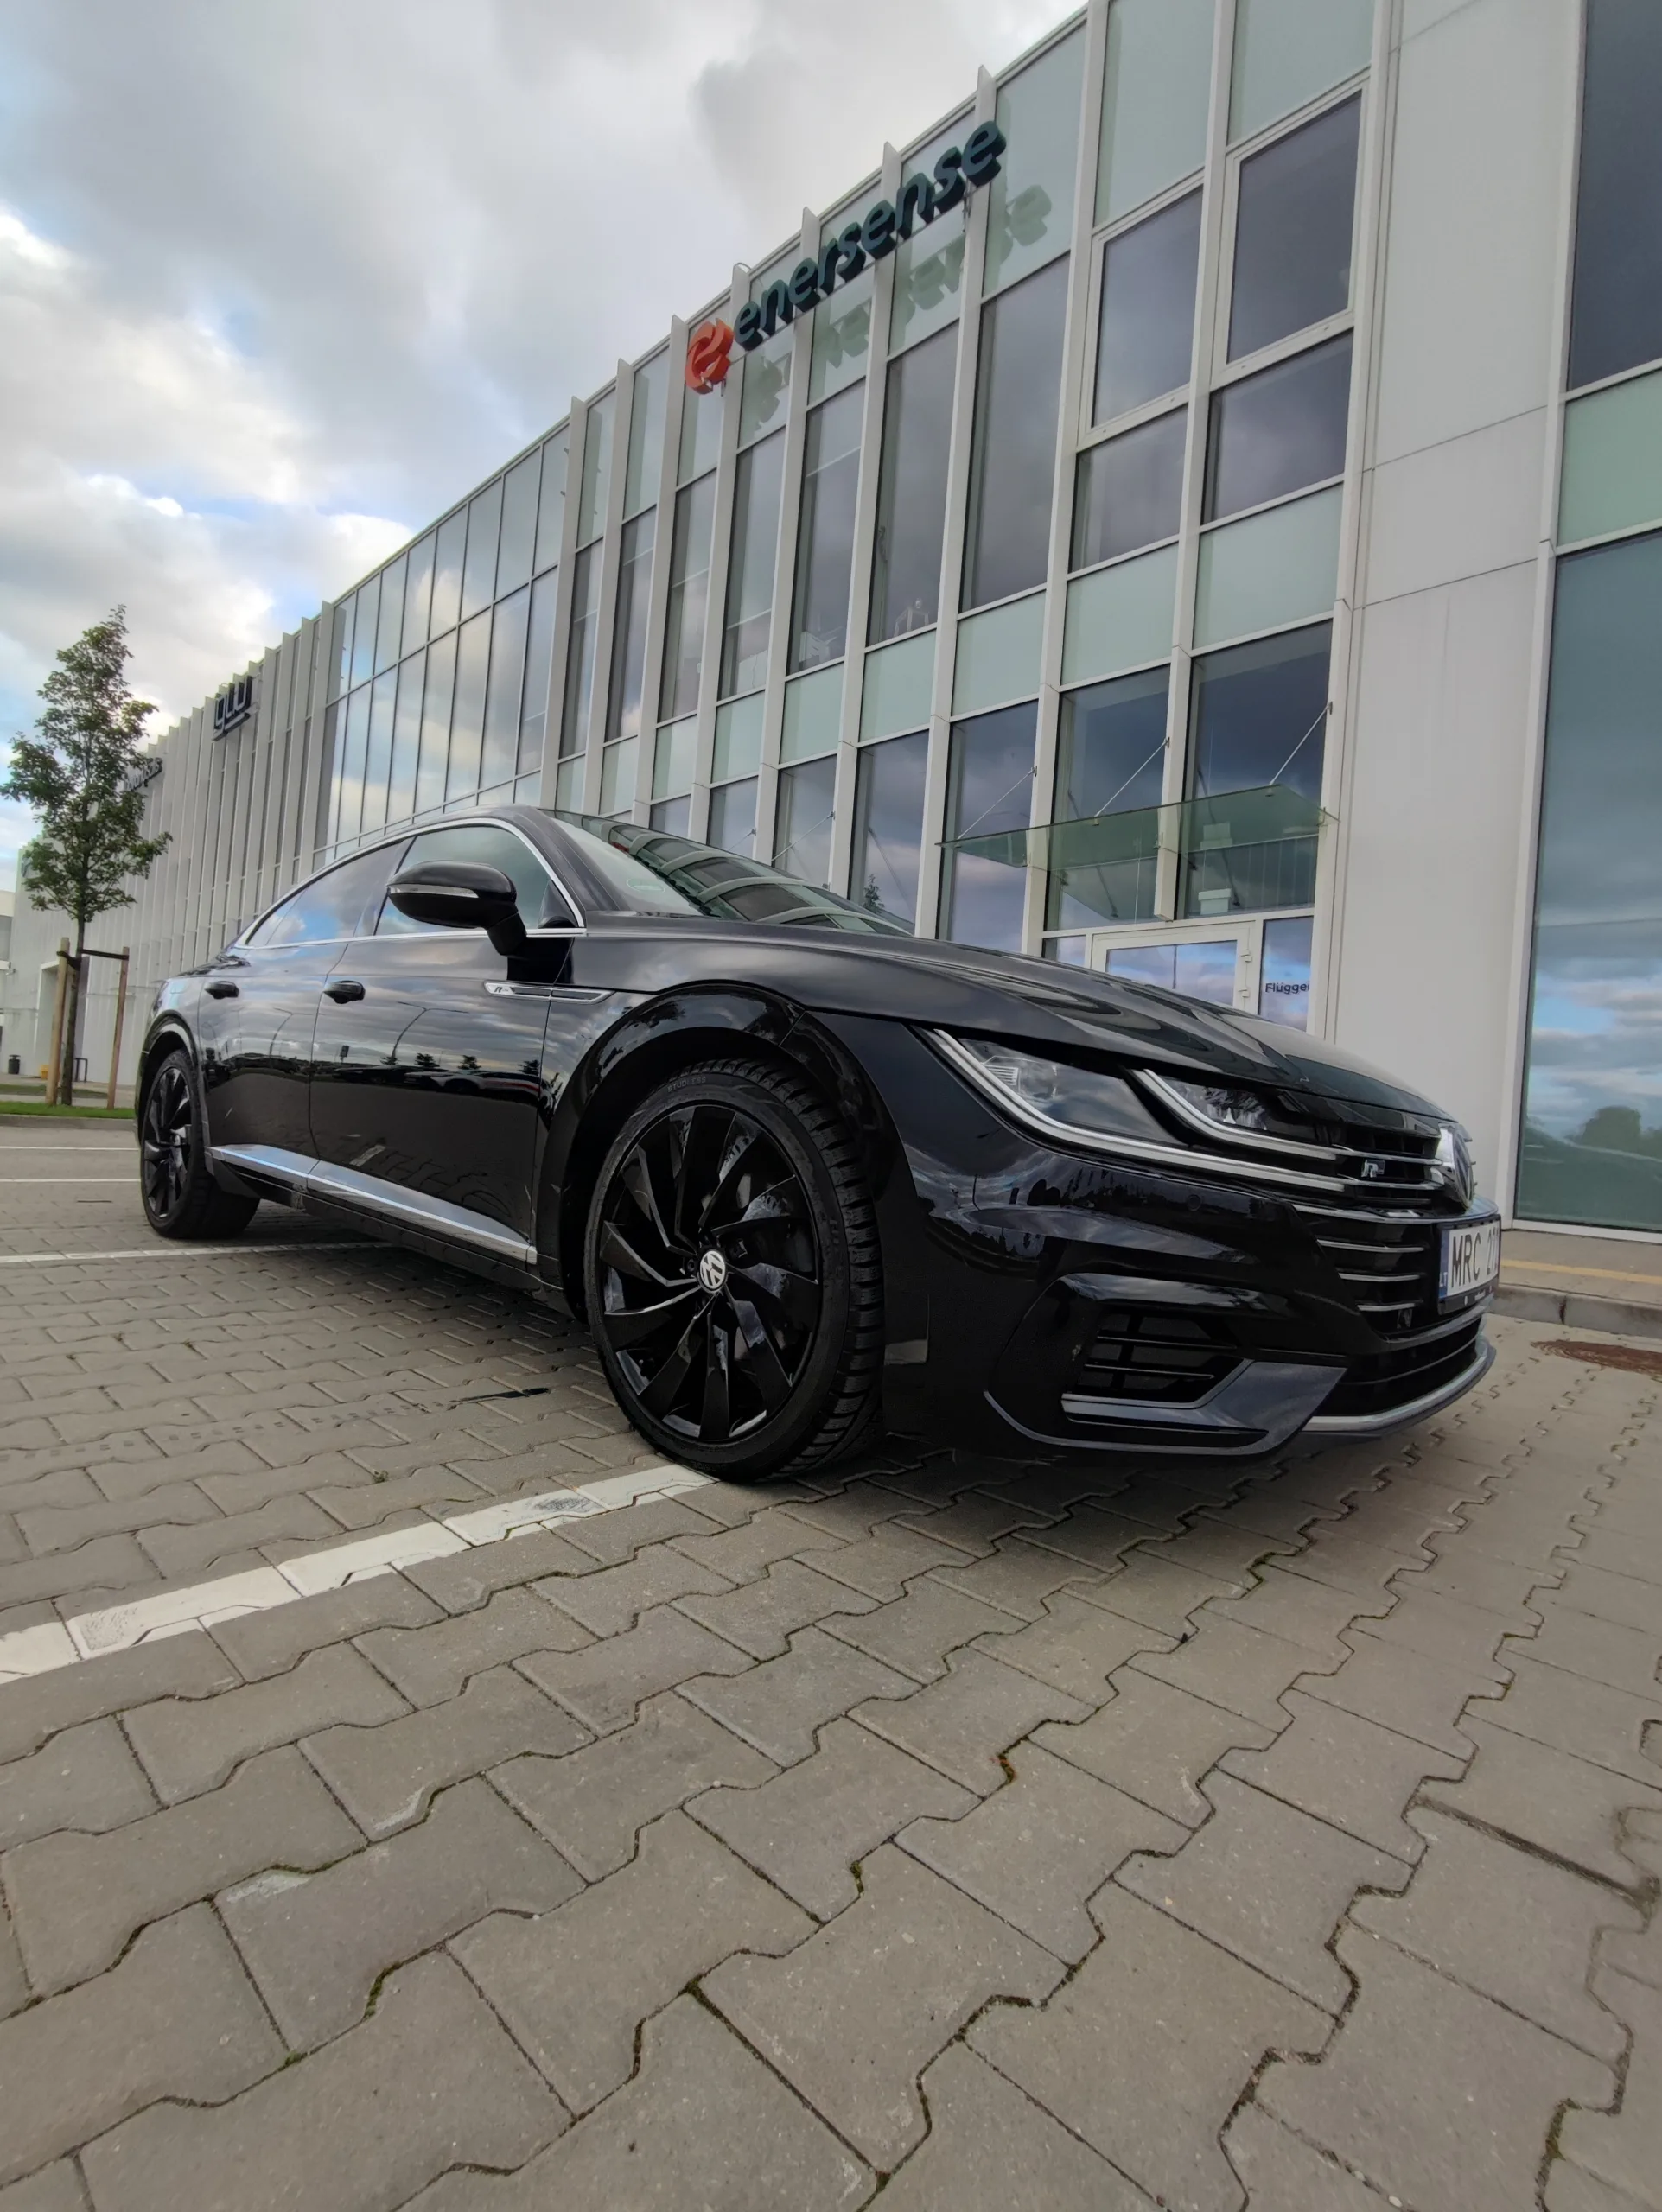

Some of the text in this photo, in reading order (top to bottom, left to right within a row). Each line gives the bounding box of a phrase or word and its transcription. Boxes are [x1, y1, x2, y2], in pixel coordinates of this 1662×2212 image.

[733, 120, 1007, 351] enersense
[667, 1076, 706, 1091] STUDLESS
[1451, 1232, 1481, 1288] MRC
